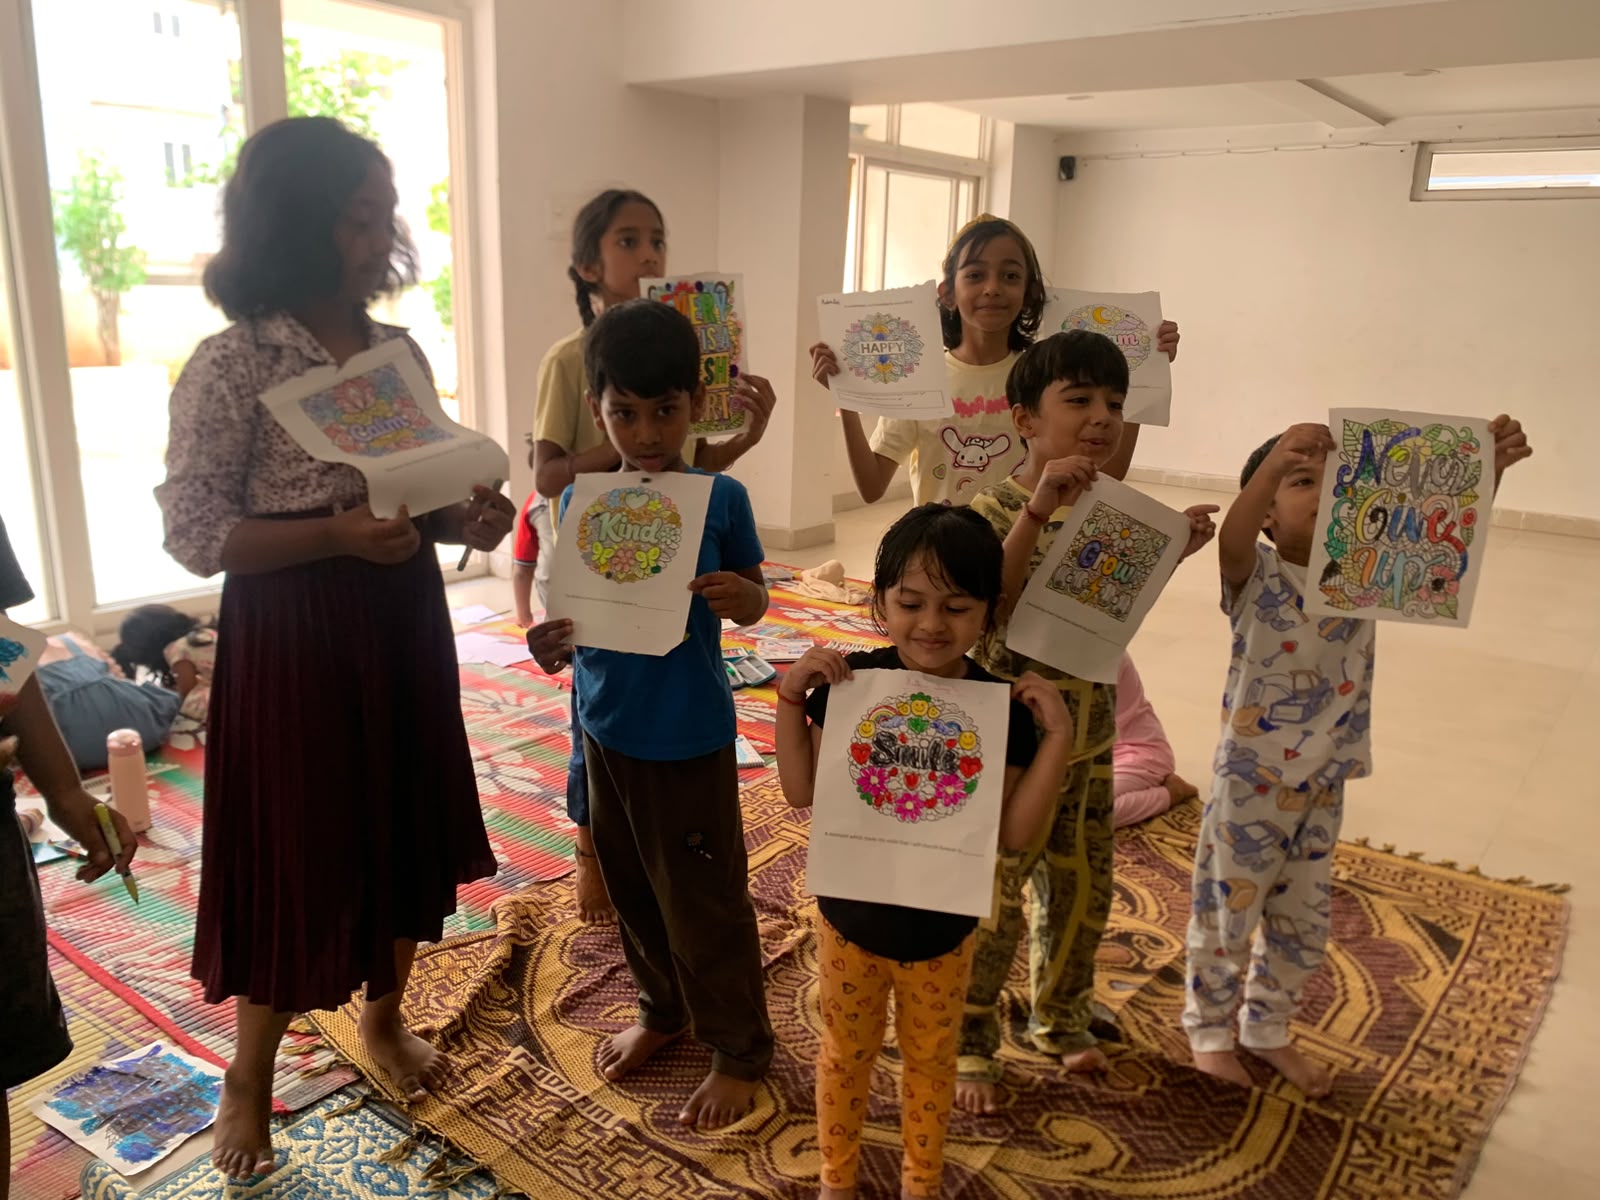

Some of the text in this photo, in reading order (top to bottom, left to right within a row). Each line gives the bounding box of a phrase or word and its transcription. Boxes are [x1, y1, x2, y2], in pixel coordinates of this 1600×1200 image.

[660, 291, 728, 326] VERY
[861, 342, 904, 354] HAPPY
[348, 416, 410, 442] Calm
[1335, 428, 1479, 498] Never
[598, 511, 663, 544] Kind
[1077, 540, 1137, 584] Grow
[870, 731, 960, 774] Smile
